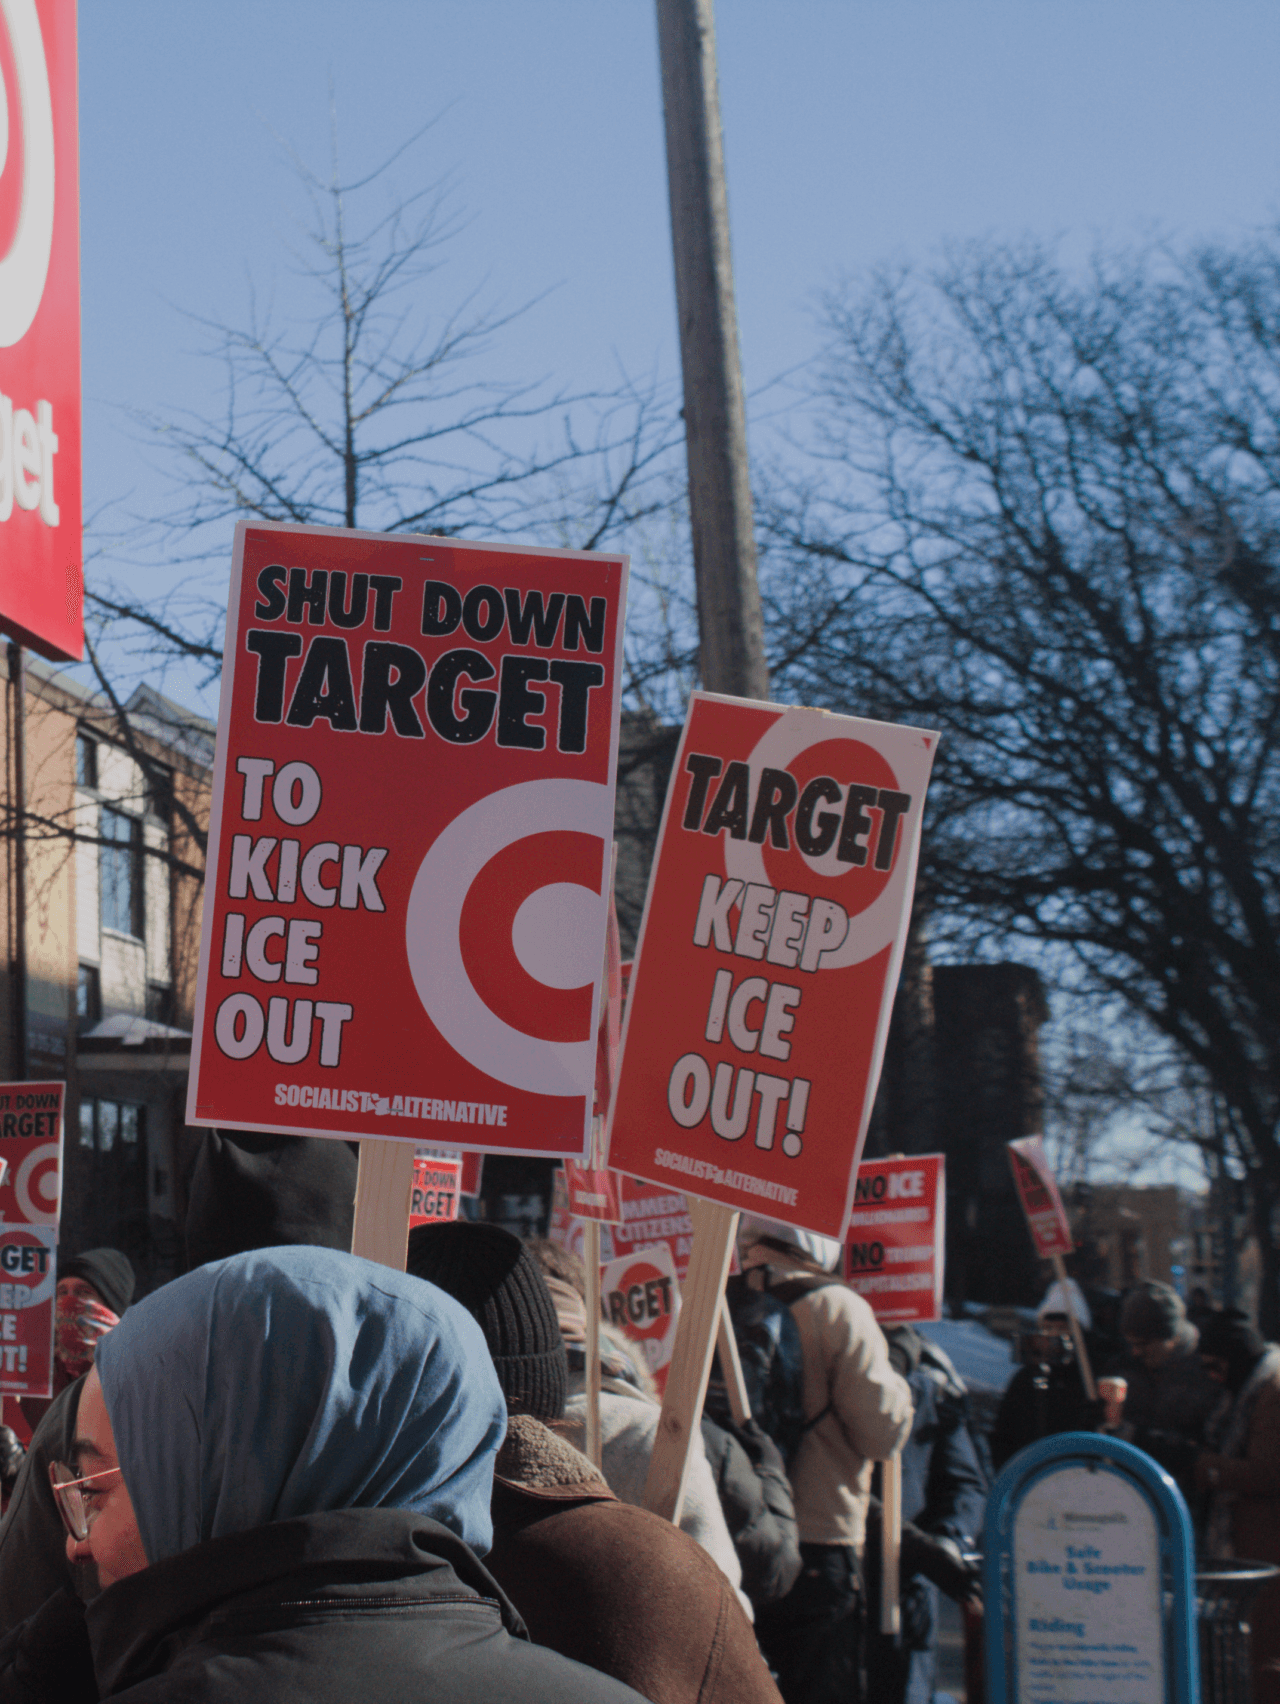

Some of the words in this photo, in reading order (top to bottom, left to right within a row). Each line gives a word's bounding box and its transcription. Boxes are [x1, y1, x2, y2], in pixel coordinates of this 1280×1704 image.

[254, 565, 402, 632] SHUT
[420, 579, 607, 654] DOWN
[246, 629, 605, 754] TARGET
[236, 756, 322, 826] TO
[682, 752, 912, 871] TARGET
[228, 833, 389, 913] KICK
[221, 913, 323, 986] ICE
[693, 873, 850, 973] KEEP
[214, 992, 353, 1068] OUT
[705, 968, 802, 1061] ICE
[16, 1093, 59, 1110] DOWN
[274, 1083, 371, 1113] SOCIALIST
[390, 1095, 507, 1127] ALTERNATIVE
[667, 1052, 811, 1158] OUT!
[411, 1189, 455, 1217] RGET
[424, 1170, 456, 1189] DOWN
[654, 1148, 714, 1181] SOCIALIST
[723, 1170, 799, 1207] ALTERNATIVE
[853, 1175, 886, 1201] NO
[888, 1170, 925, 1199] ICE
[616, 1214, 693, 1242] CITIZENS
[850, 1241, 884, 1268] NO
[602, 1276, 672, 1326] RGET
